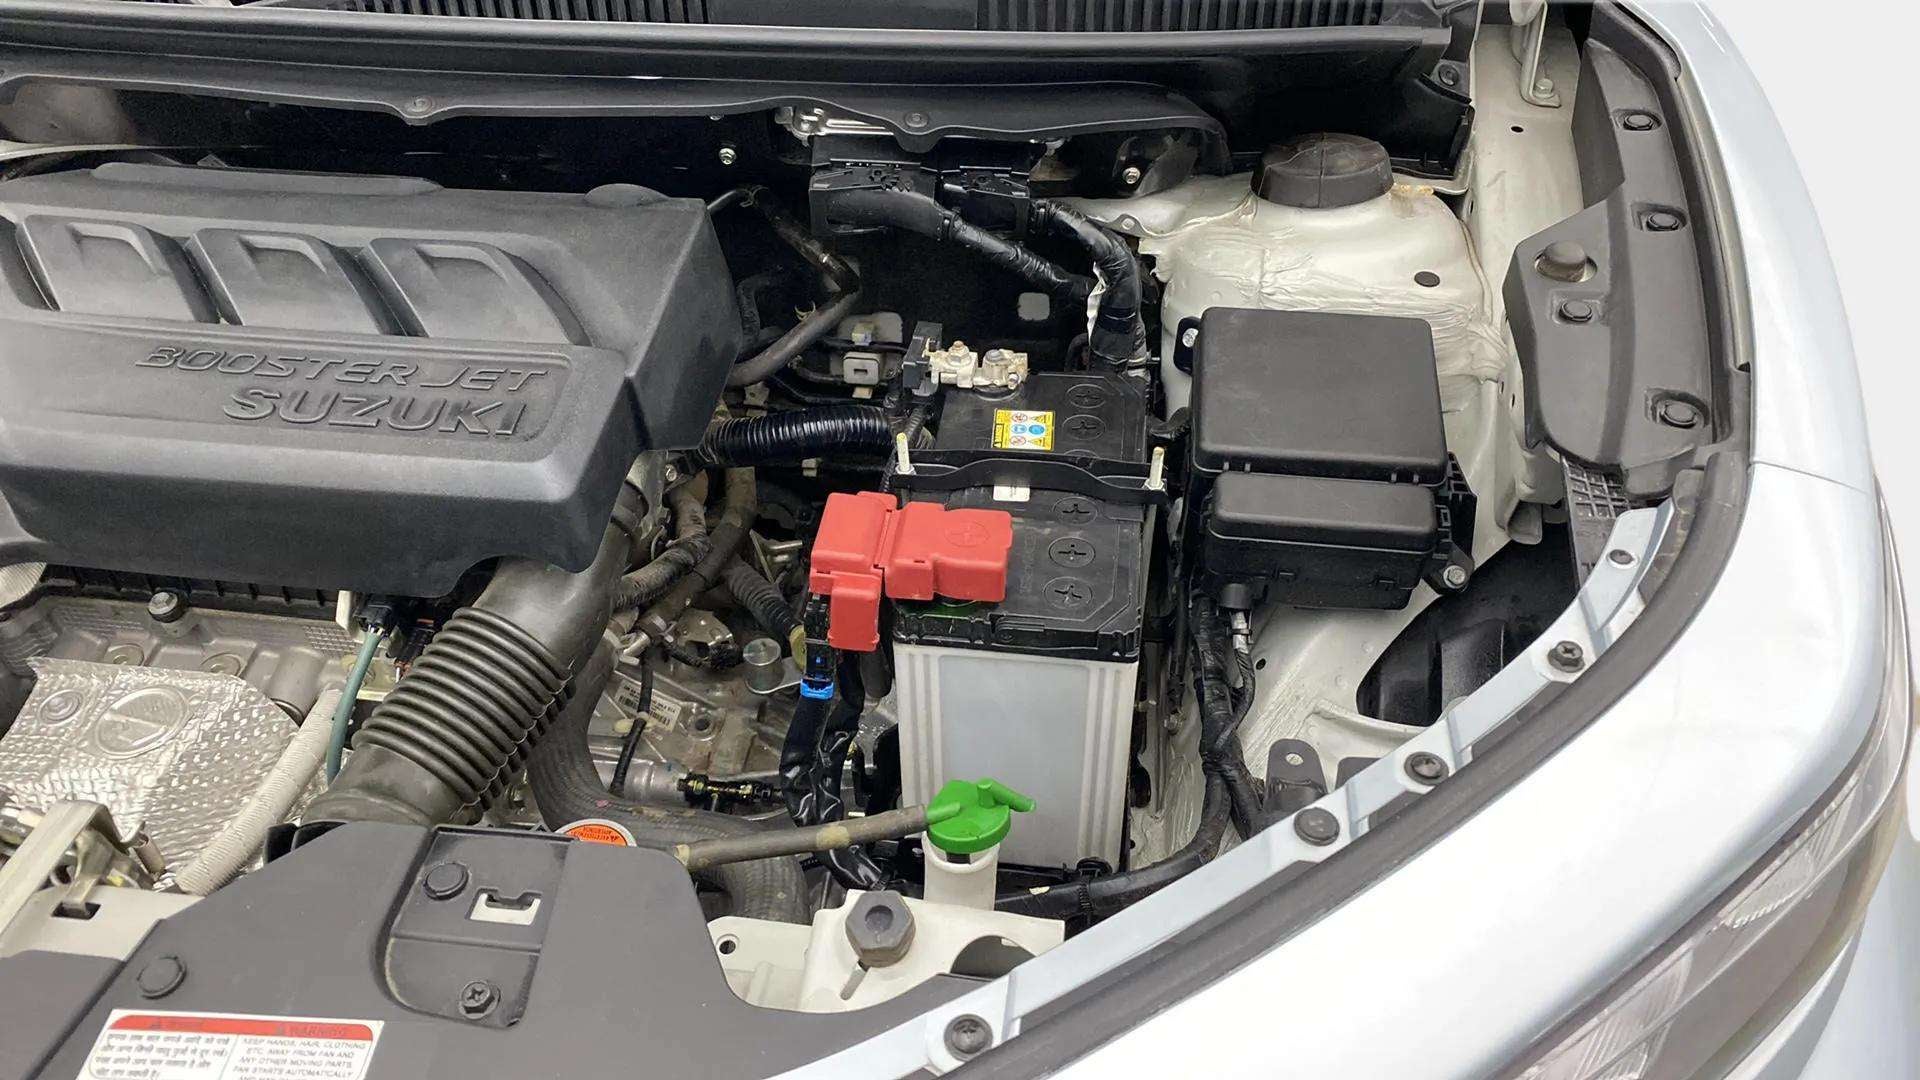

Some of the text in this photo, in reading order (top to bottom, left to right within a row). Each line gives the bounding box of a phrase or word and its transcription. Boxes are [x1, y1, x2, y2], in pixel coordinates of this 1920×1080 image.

[134, 346, 550, 392] BOOSTER JET
[223, 386, 528, 437] SUZUKI
